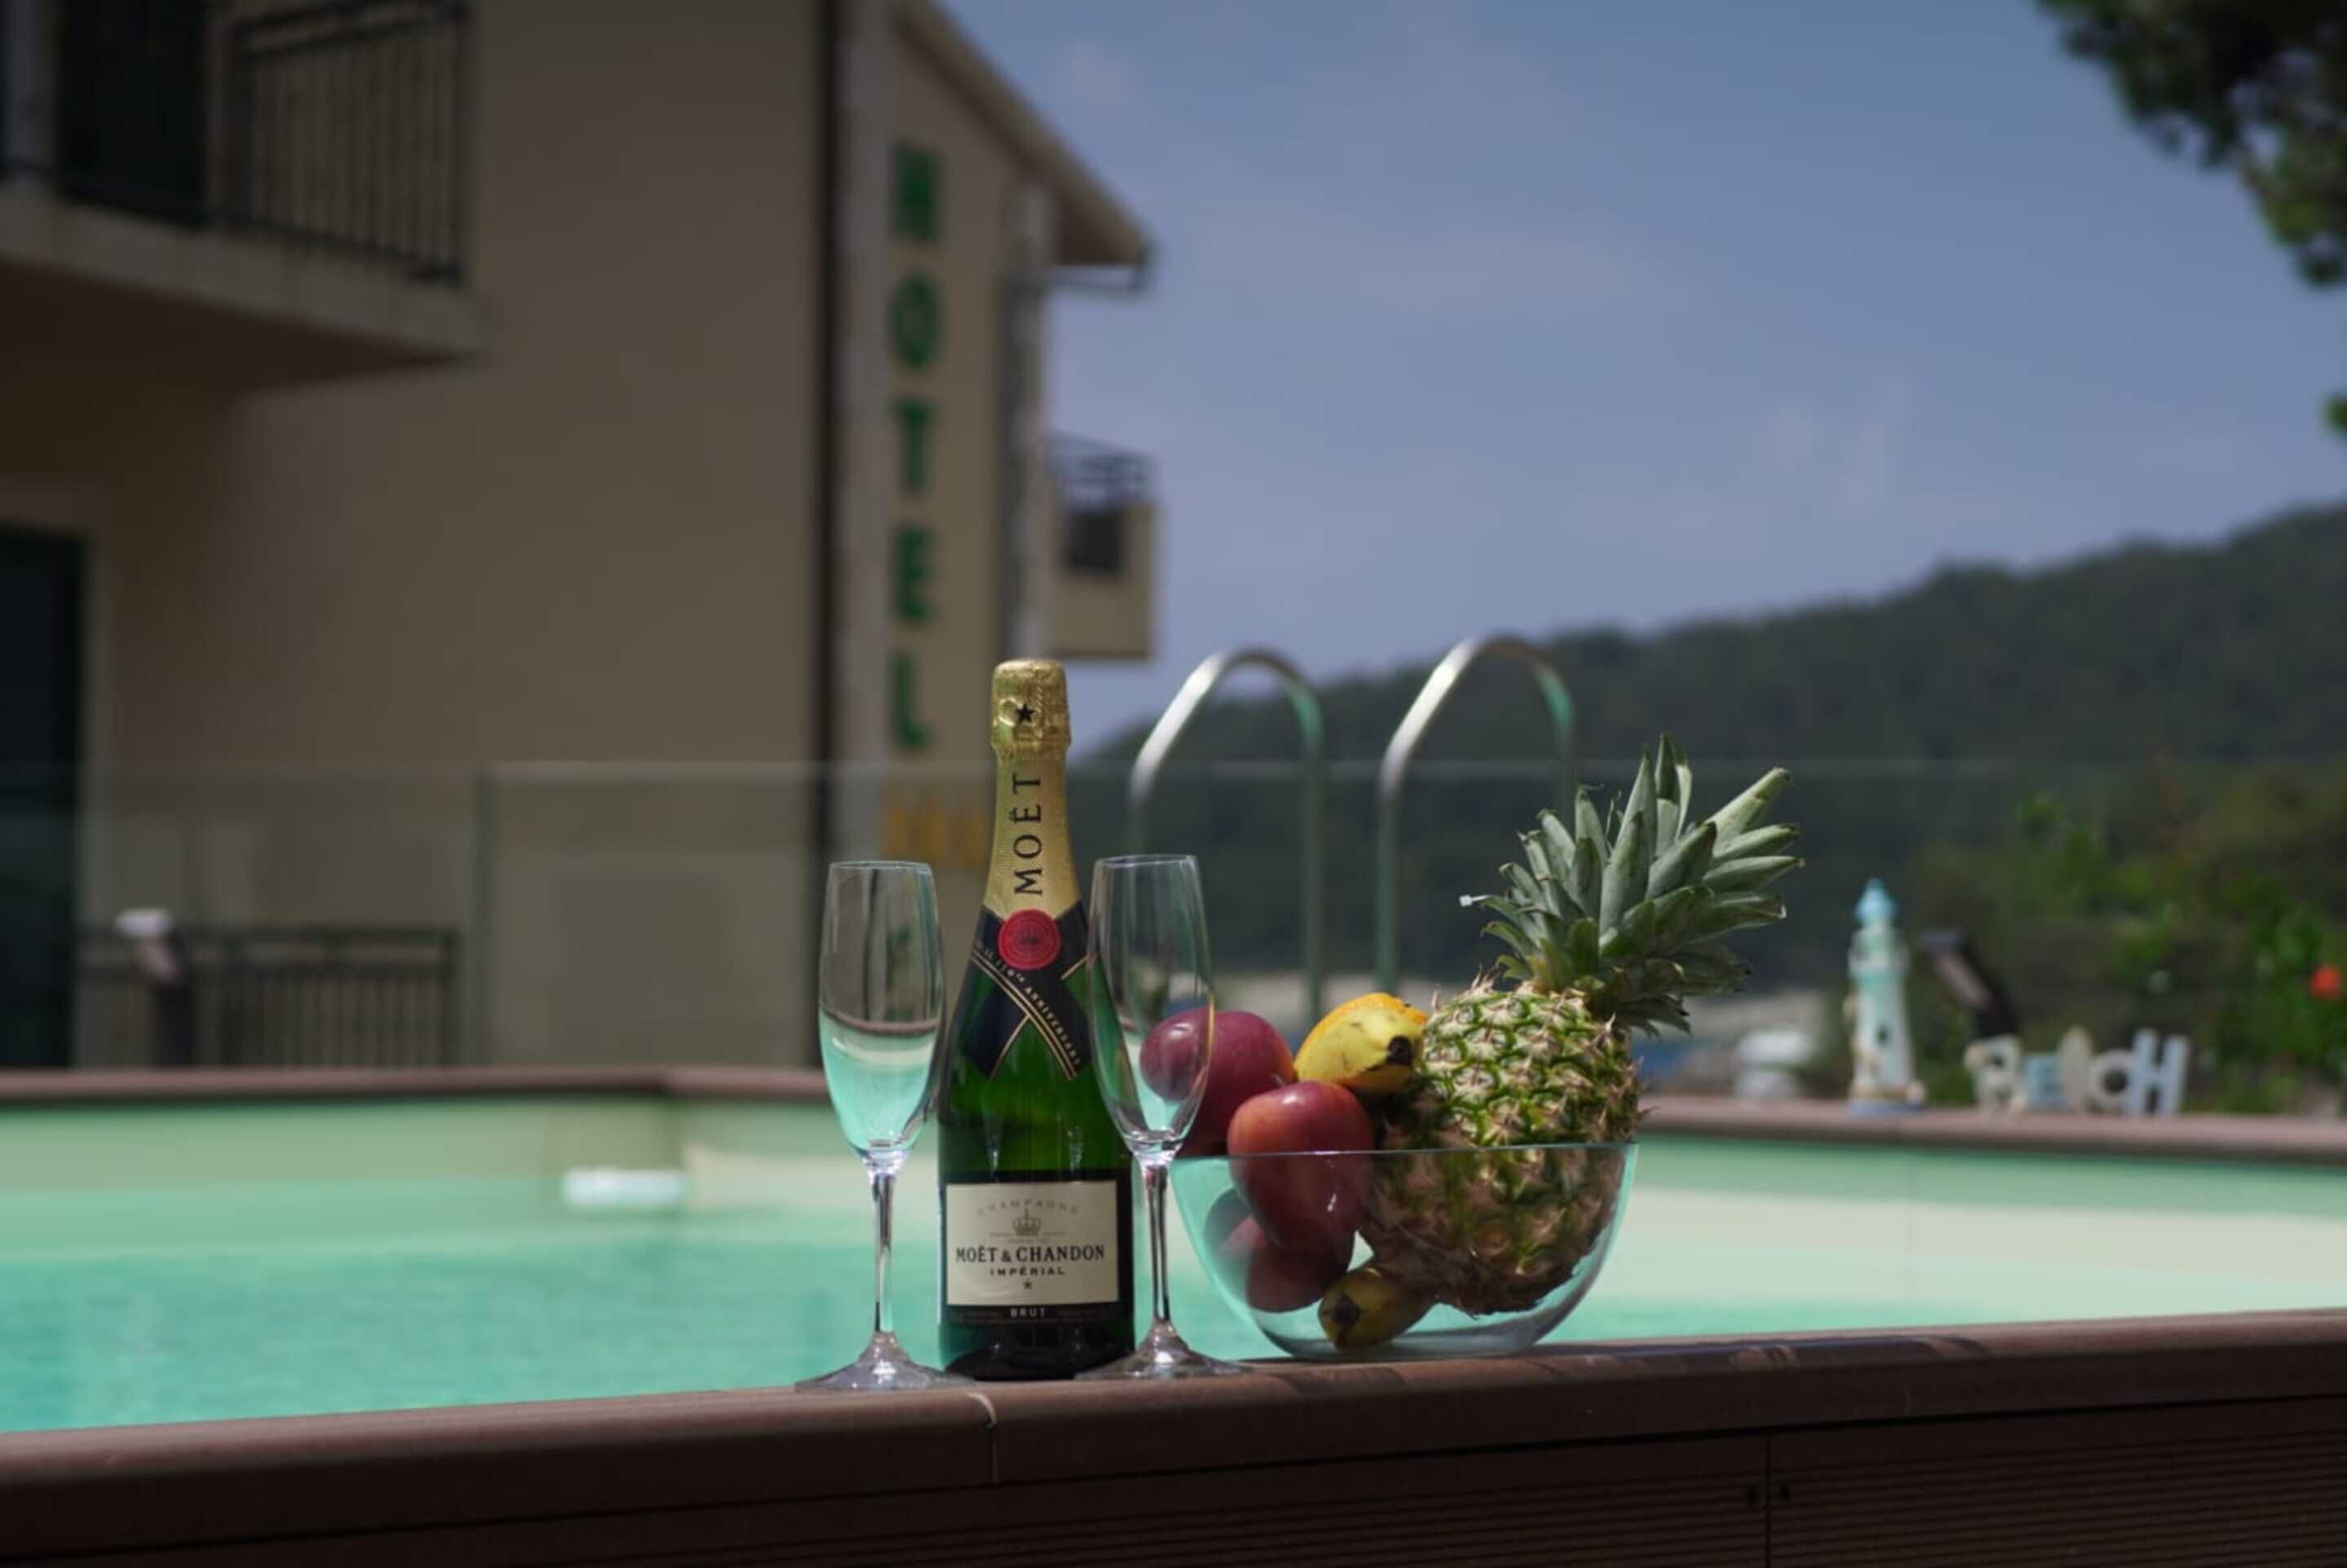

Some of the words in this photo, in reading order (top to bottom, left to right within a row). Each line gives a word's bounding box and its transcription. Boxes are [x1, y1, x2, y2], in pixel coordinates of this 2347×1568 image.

[890, 143, 942, 750] HOTEL
[1010, 773, 1042, 896] MOËT
[956, 1244, 997, 1263] MOËT
[1001, 1249, 1011, 1262] &
[1016, 1244, 1105, 1262] CHANDON
[989, 1266, 1066, 1276] IMPÉRIAL
[1011, 1307, 1046, 1318] BRUT
